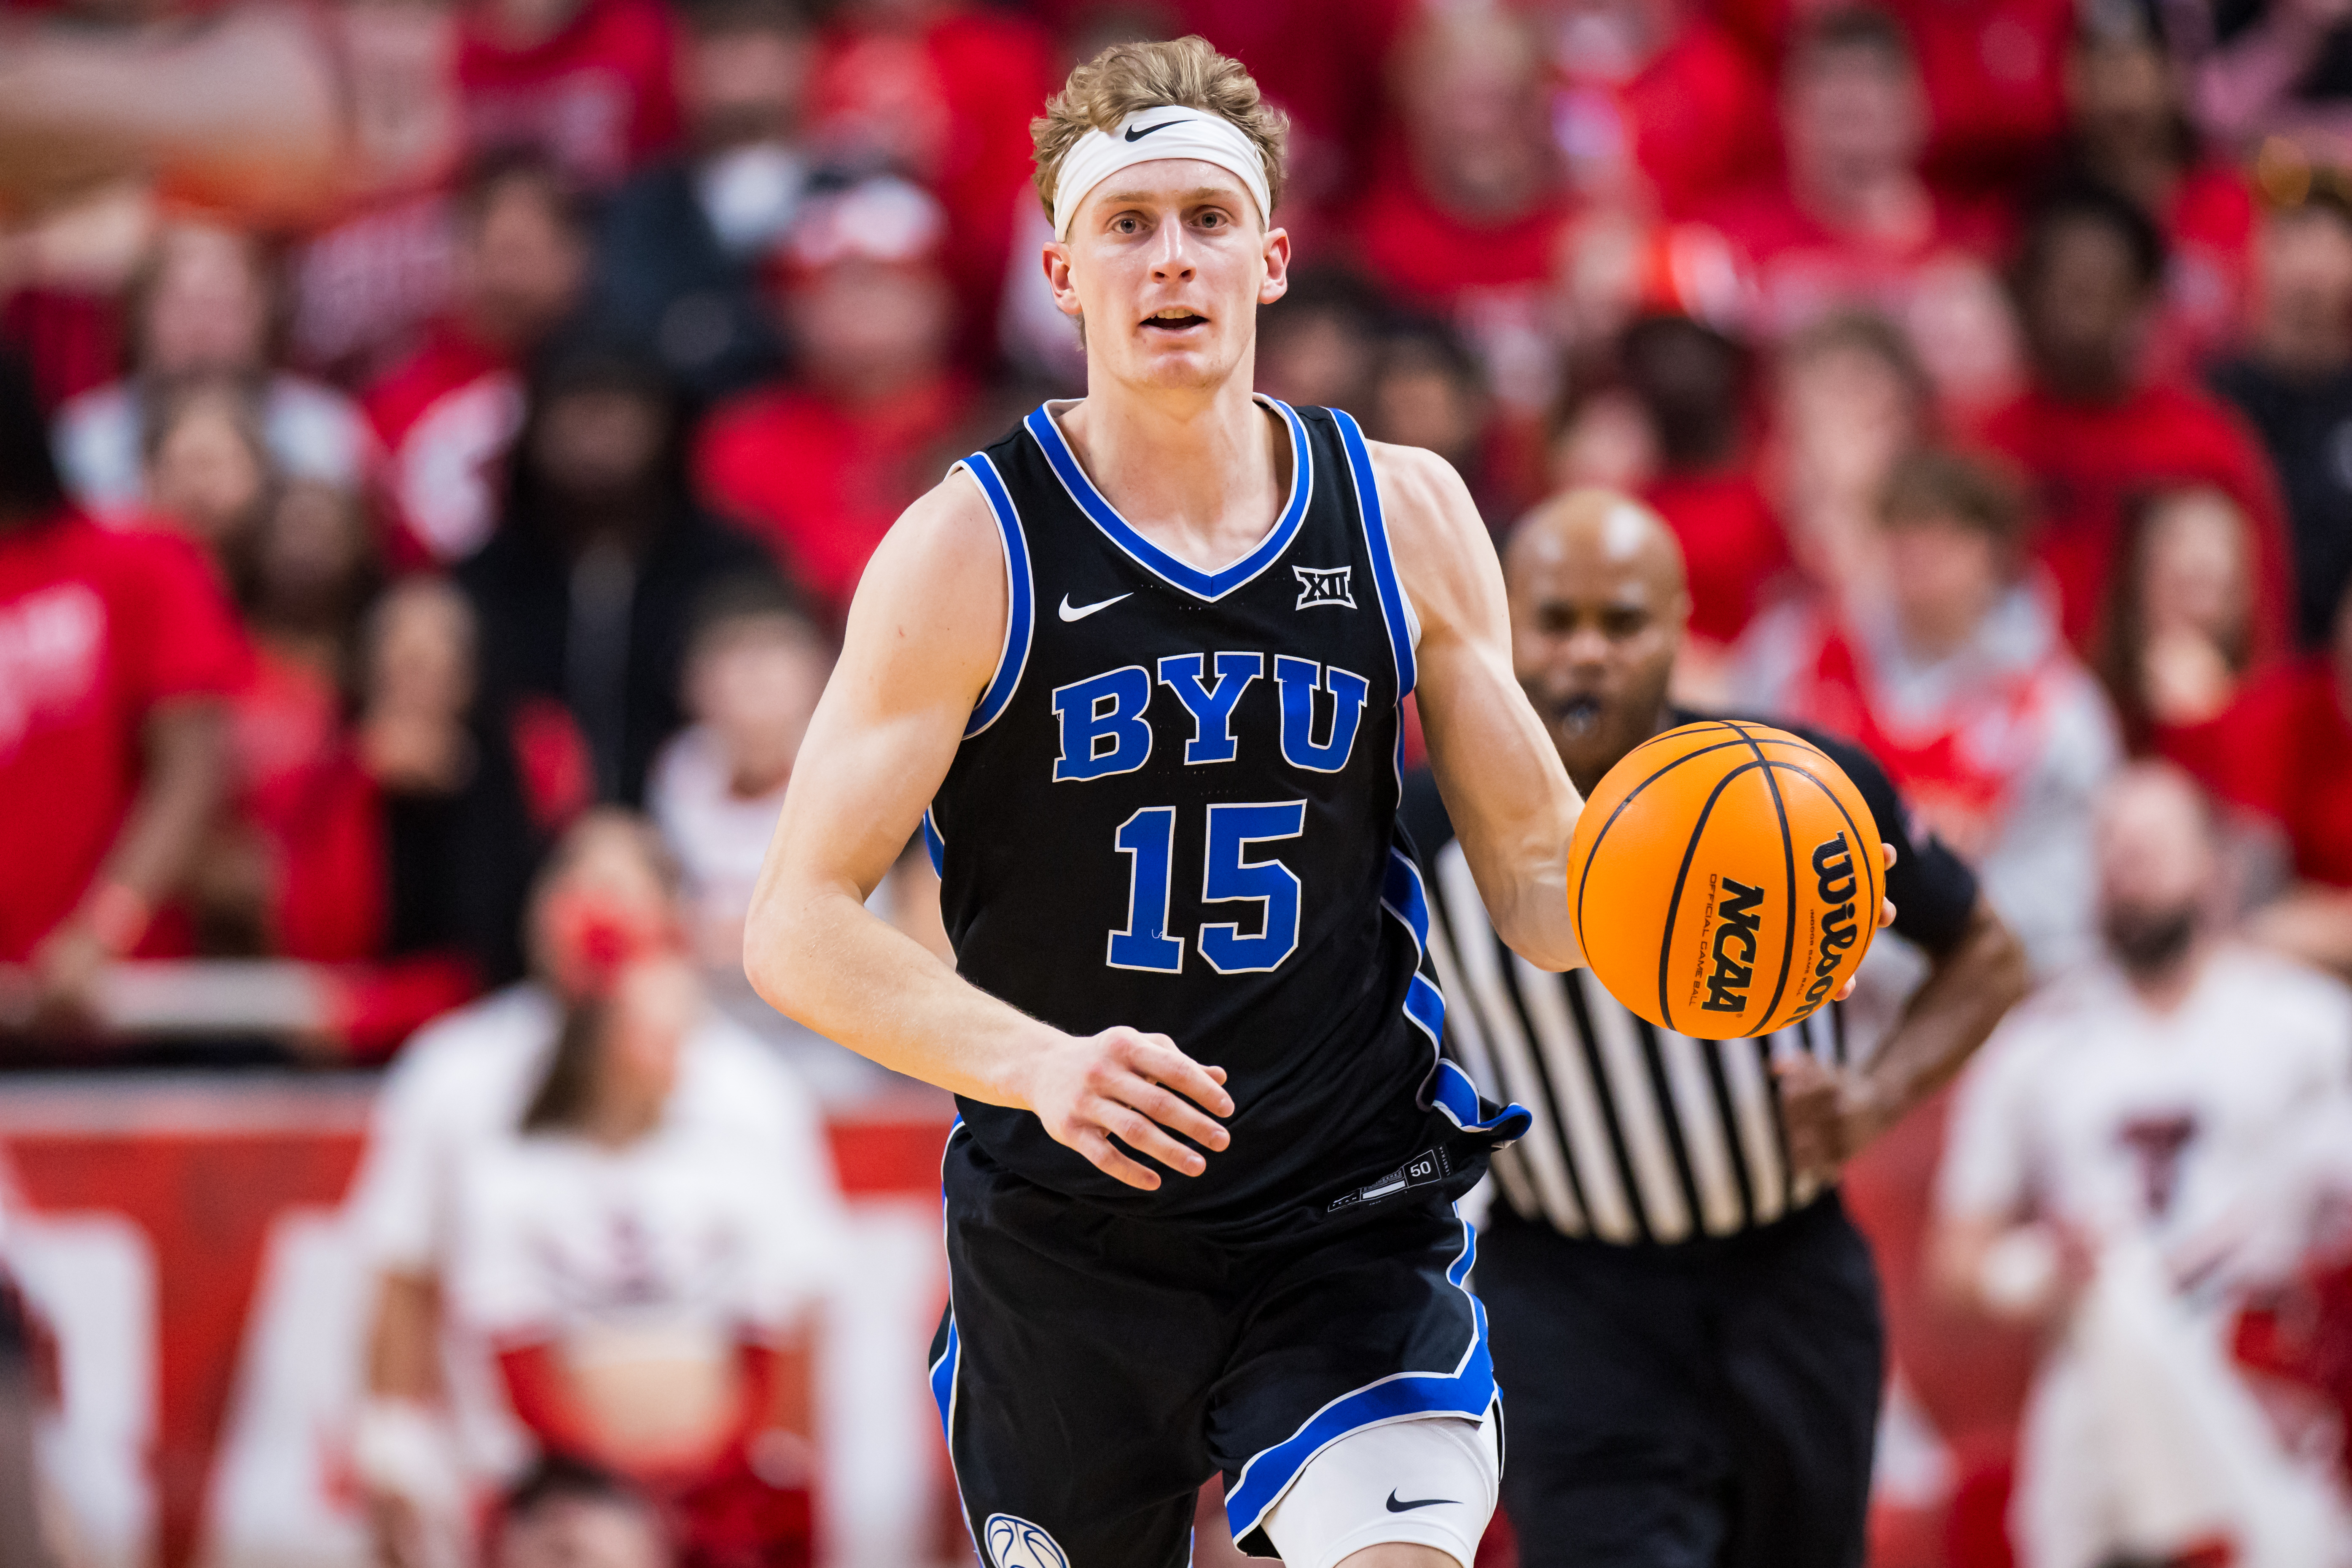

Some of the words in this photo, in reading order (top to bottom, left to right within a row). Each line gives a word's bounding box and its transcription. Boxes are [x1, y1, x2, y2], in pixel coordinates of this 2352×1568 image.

[1293, 566, 1357, 610] XII
[1052, 651, 1369, 782] BYU
[1106, 799, 1307, 974] 15
[1702, 874, 1717, 937] OFFICIAL
[1695, 941, 1707, 978] GAME
[1701, 877, 1765, 1013] NCAA
[1776, 830, 1857, 1029] Wilson
[1689, 980, 1701, 1006] BALL
[1410, 1161, 1432, 1177] 50
